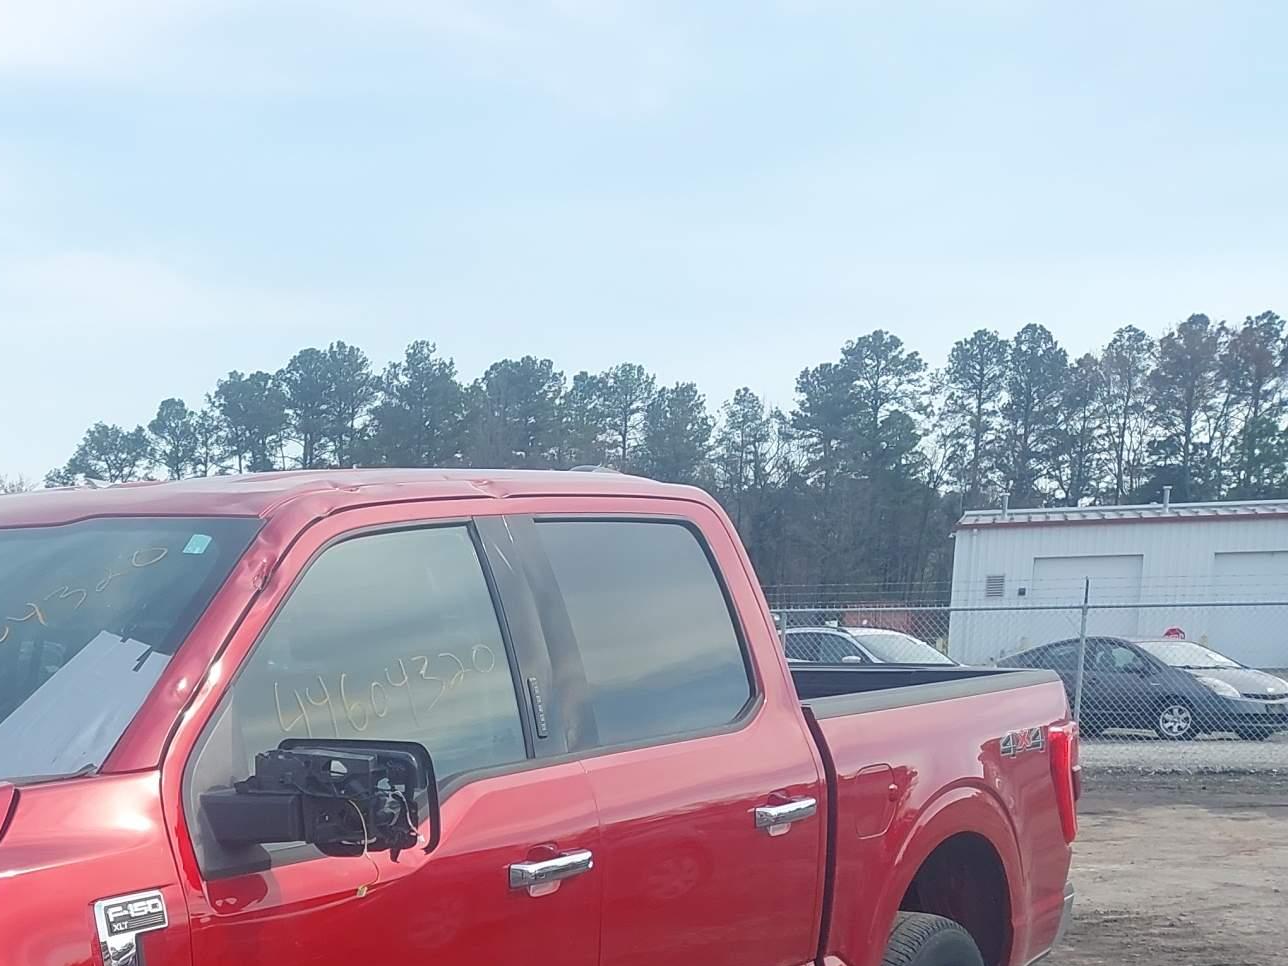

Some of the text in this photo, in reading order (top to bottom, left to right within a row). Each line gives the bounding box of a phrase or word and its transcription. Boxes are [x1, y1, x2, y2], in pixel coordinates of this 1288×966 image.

[273, 644, 495, 738] 44604320
[107, 898, 163, 922] F-150
[113, 921, 128, 931] XLT
